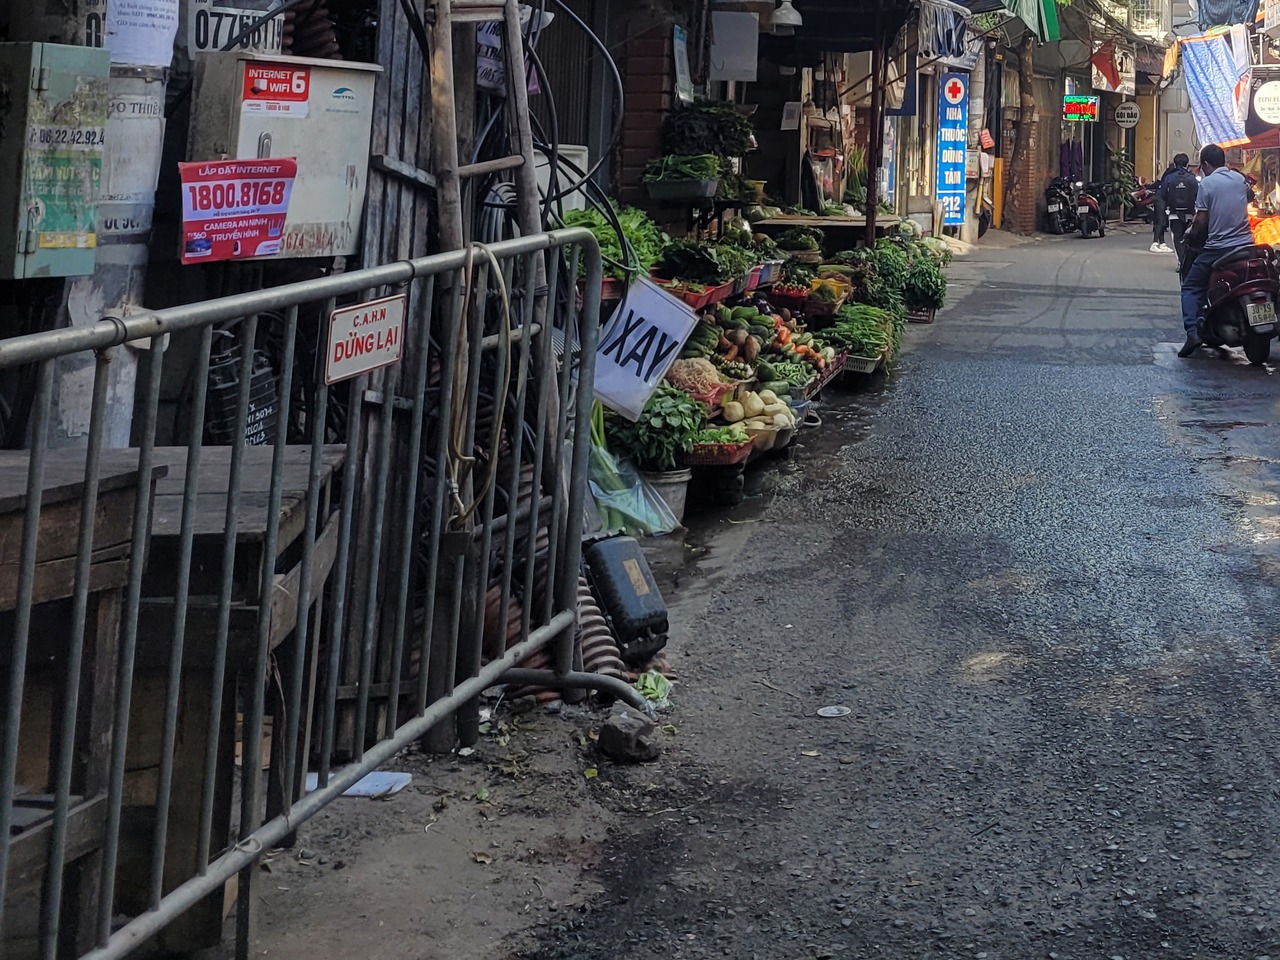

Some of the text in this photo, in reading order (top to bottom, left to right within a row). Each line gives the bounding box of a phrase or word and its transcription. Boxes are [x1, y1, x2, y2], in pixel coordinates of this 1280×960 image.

[248, 69, 306, 94] INTERNET 6
[270, 83, 290, 93] WIFI
[946, 104, 962, 120] NHÀ
[941, 123, 966, 142] THUỐC
[198, 164, 216, 176] LẮP
[237, 166, 282, 174] INTERNET
[188, 181, 286, 212] 1800.8168
[943, 196, 960, 212] 212
[204, 221, 237, 232] CAMERA
[238, 220, 248, 228] AN
[354, 308, 386, 328] C.A.H.N
[334, 325, 398, 362] DỪNG LẠI
[602, 309, 679, 382] XAY
